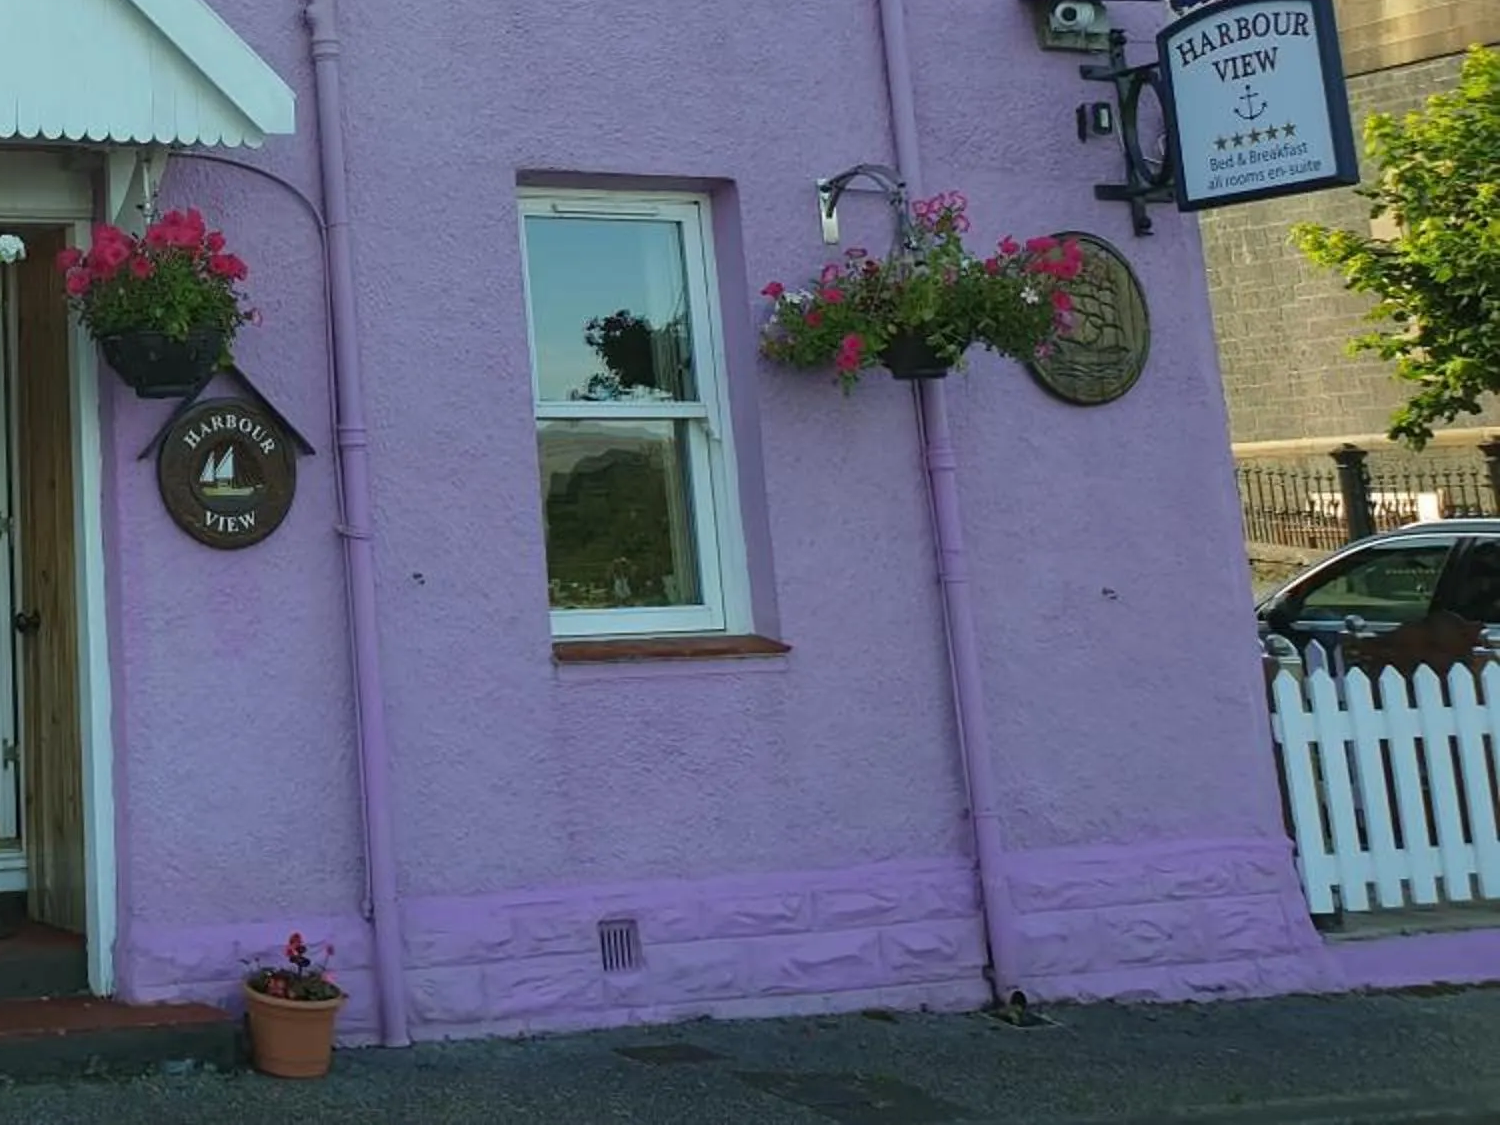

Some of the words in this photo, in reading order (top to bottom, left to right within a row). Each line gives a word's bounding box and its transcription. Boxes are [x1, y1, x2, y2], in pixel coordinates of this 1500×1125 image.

[1176, 12, 1310, 67] HARBOUR
[1212, 46, 1278, 82] VIEW
[1209, 155, 1235, 171] Bed
[1237, 153, 1247, 166] &
[1249, 142, 1308, 164] Breakfast
[1225, 171, 1265, 188] rooms
[184, 414, 276, 455] HARBOUR
[205, 511, 256, 532] VIEW
